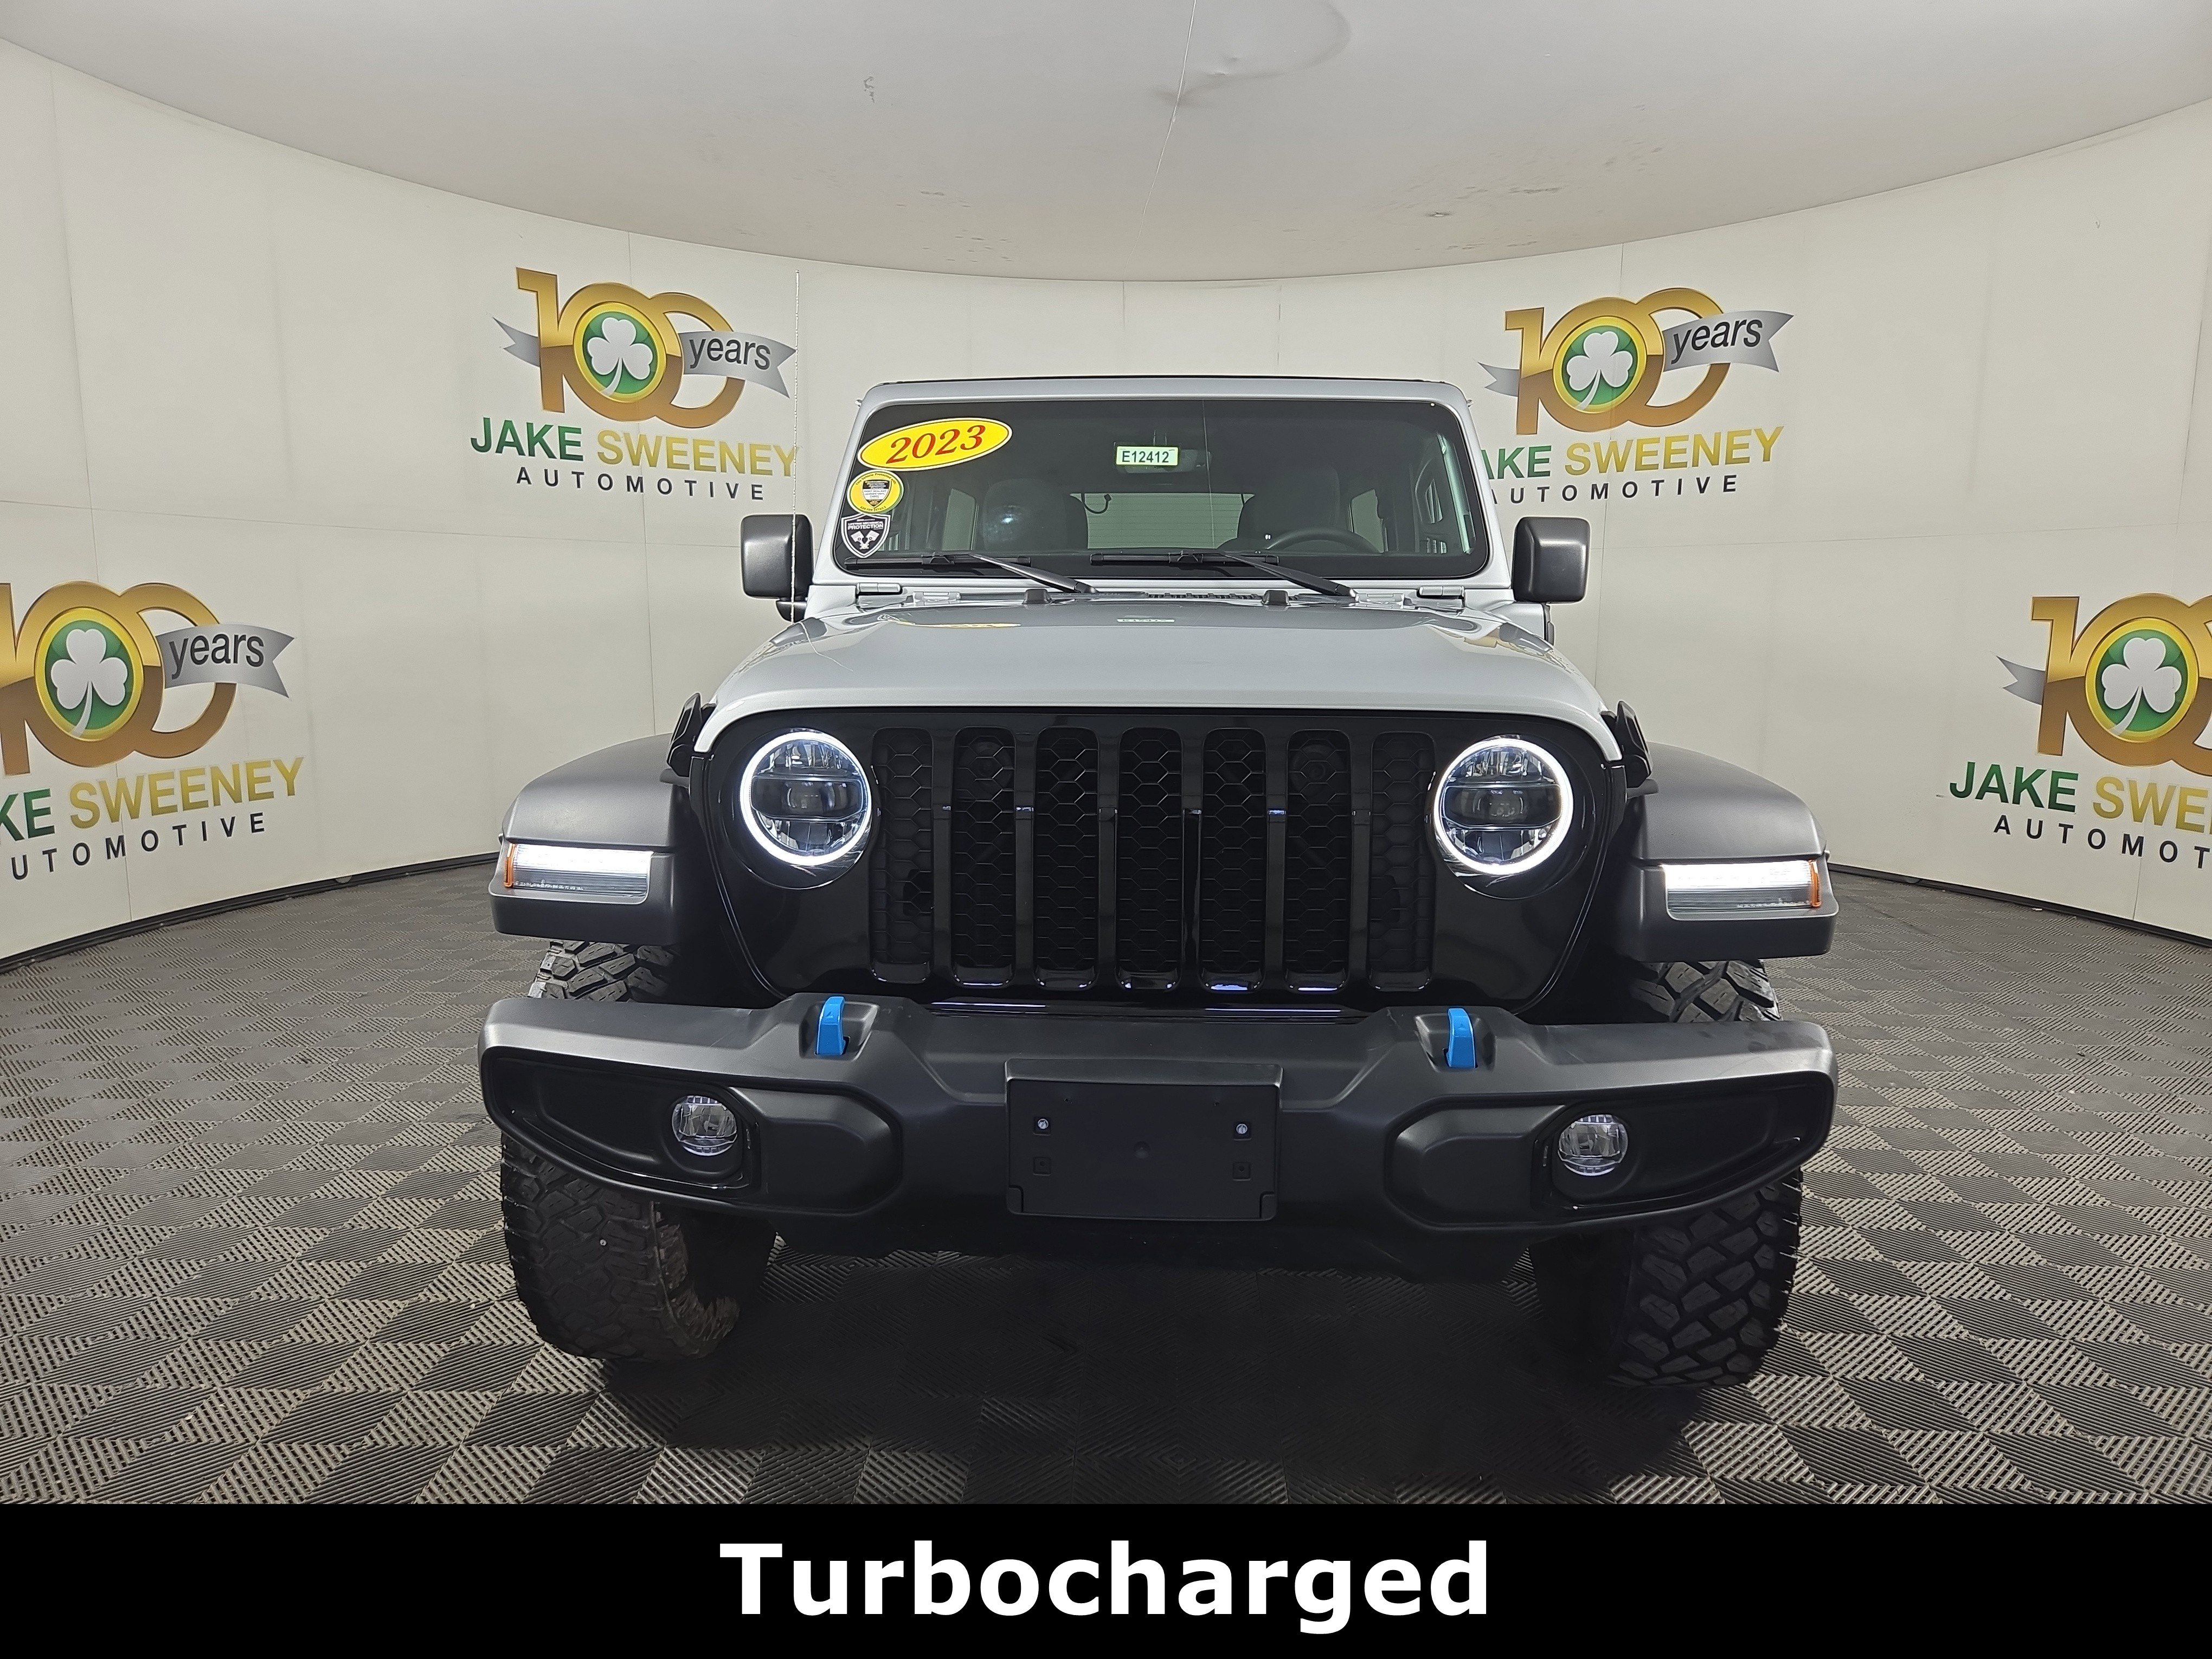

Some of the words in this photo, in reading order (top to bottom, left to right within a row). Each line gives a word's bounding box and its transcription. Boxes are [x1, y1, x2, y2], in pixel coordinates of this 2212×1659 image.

[689, 334, 771, 370] years
[1670, 319, 1763, 364] years
[470, 417, 584, 461] JAKE
[597, 430, 798, 477] SWEENEY
[886, 425, 986, 465] 2023
[1122, 451, 1169, 463] E12412
[1481, 445, 1552, 480] KE
[1564, 426, 1785, 476] SWEENEY
[516, 466, 764, 500] AUTOMOTIVE
[169, 632, 265, 680] years
[69, 757, 305, 829] SWEENEY
[1949, 761, 2080, 813] JAKE
[1994, 814, 2210, 869] AUTOMOT
